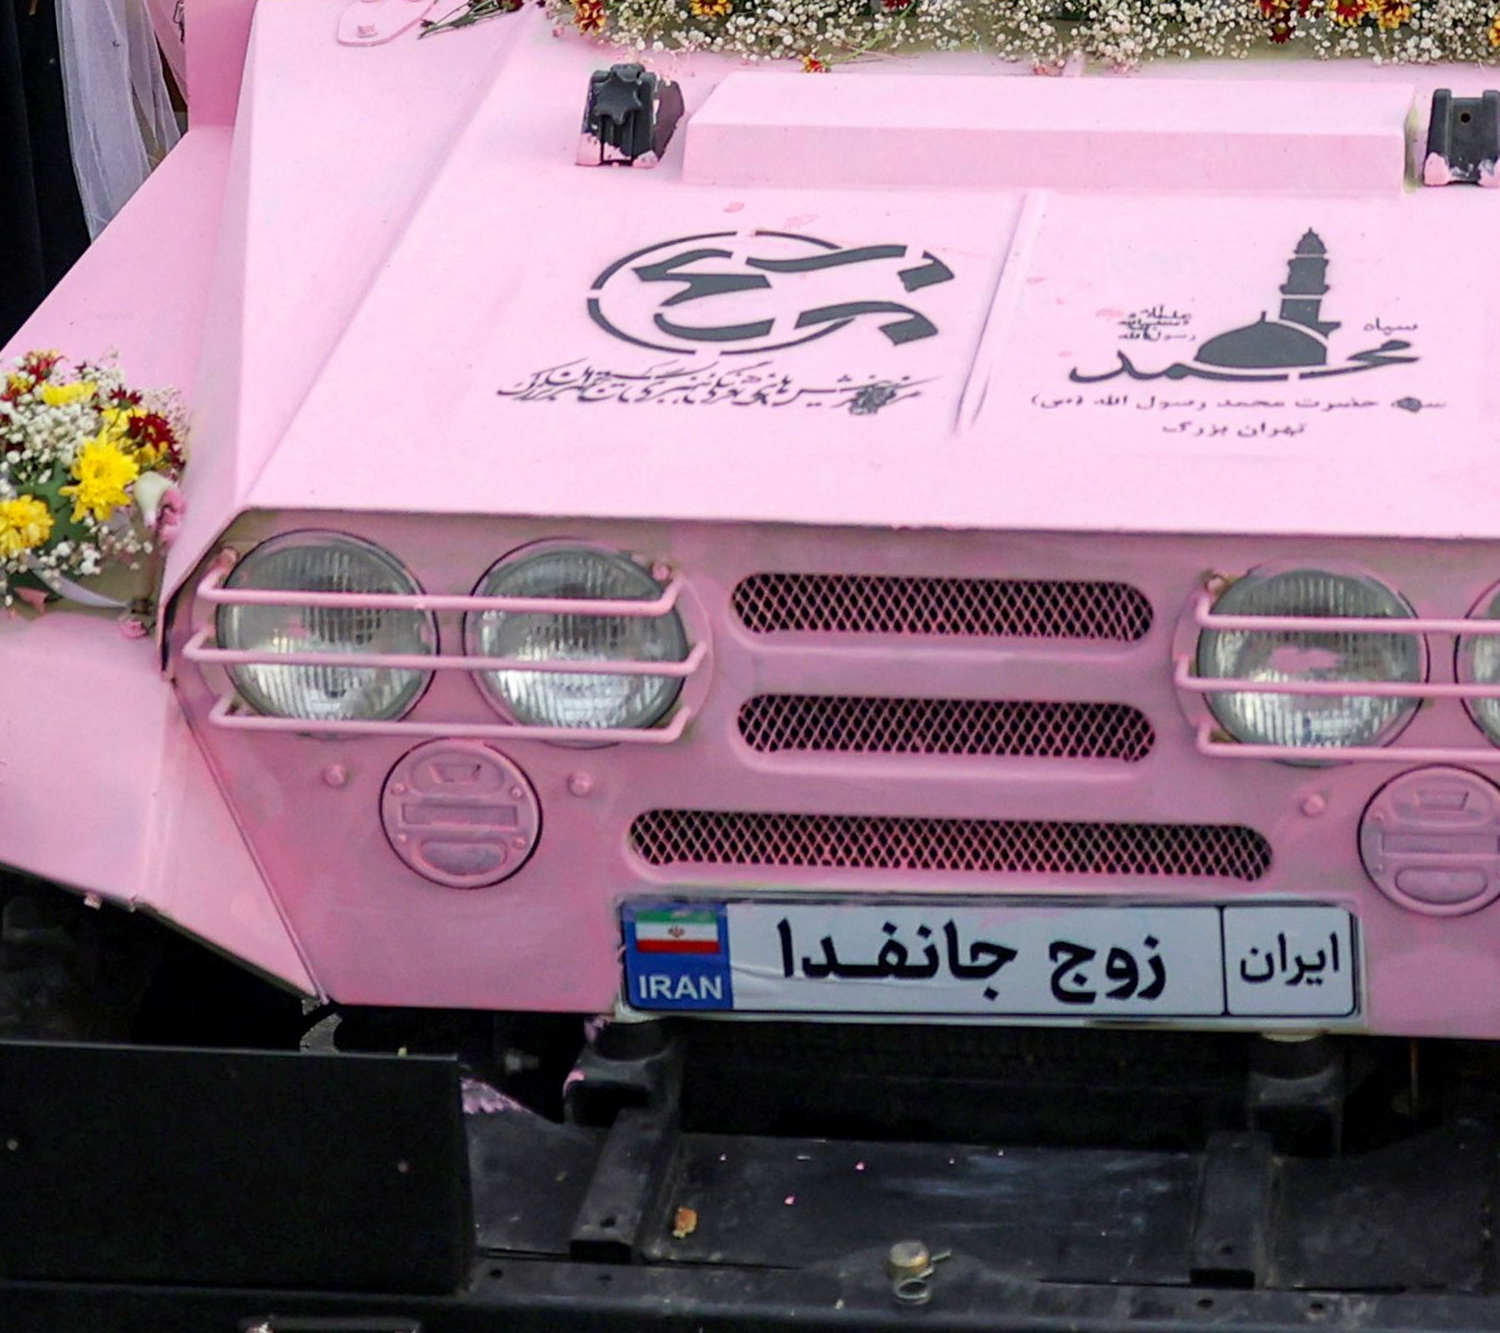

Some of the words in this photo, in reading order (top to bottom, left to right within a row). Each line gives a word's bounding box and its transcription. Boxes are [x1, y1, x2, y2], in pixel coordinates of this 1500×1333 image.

[638, 974, 723, 1002] IRAN
[777, 919, 1018, 1000] جانفدا
[1047, 934, 1168, 1004] زوج
[1238, 931, 1340, 988] ایران
